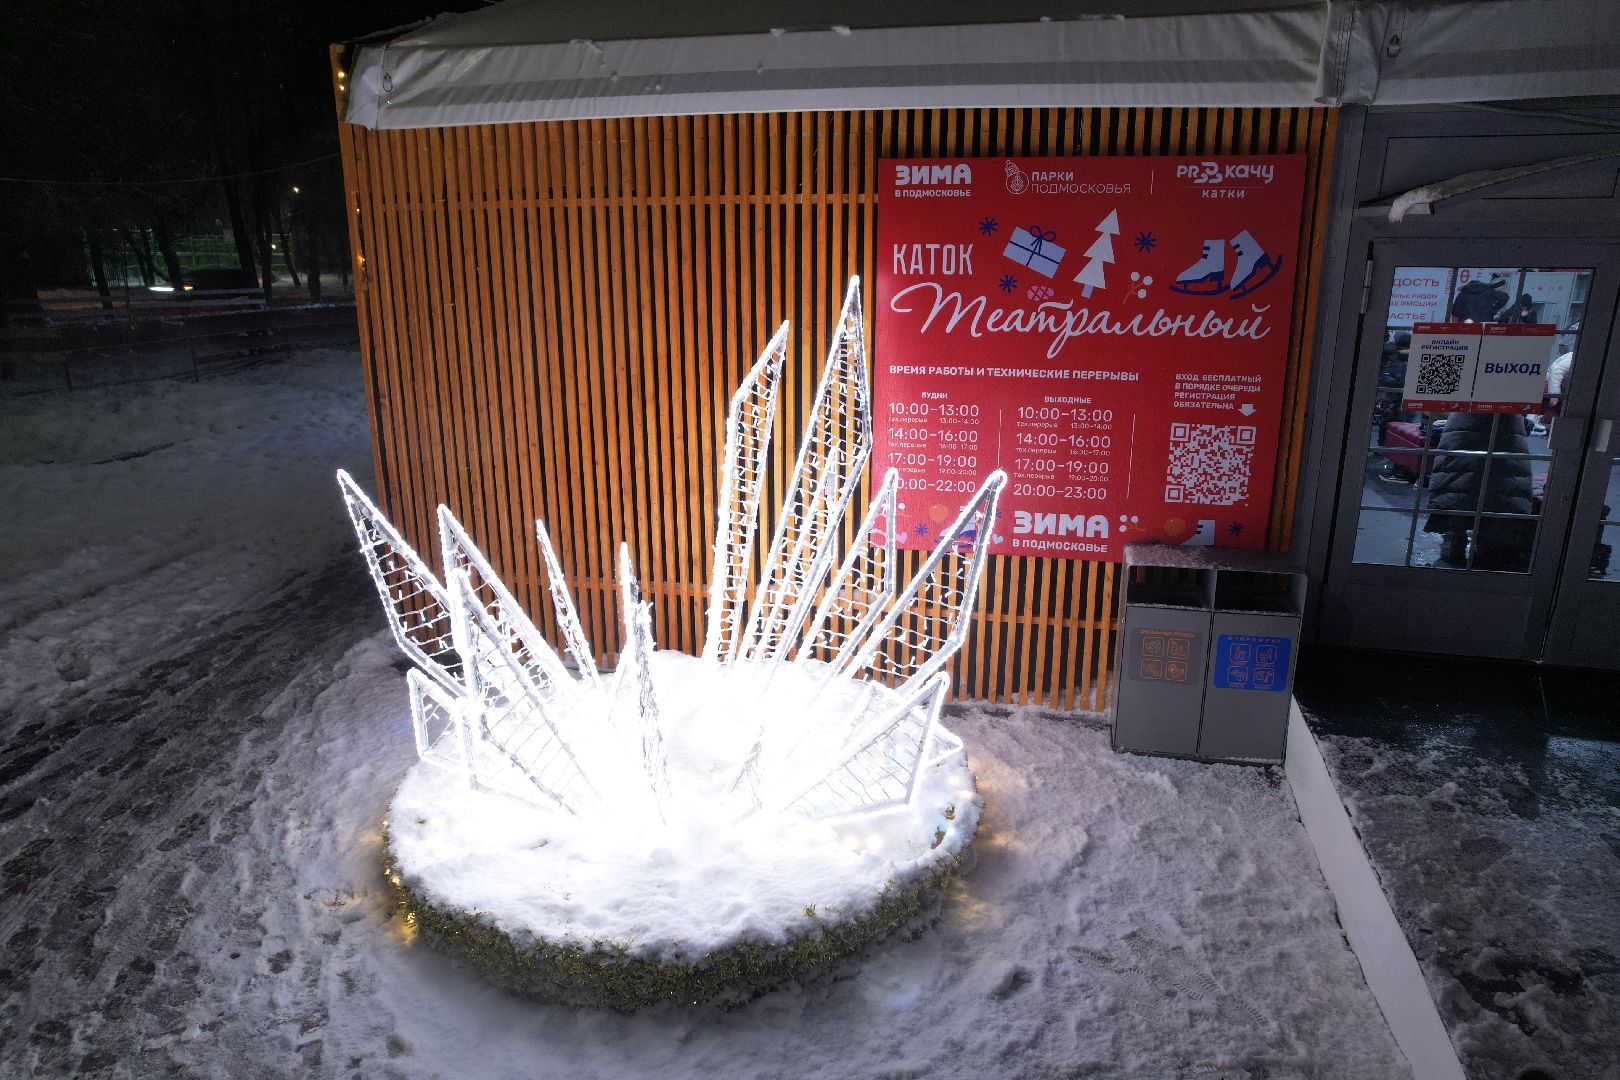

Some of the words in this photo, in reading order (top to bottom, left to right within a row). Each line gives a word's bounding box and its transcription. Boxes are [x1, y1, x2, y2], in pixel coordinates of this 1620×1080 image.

[895, 164, 972, 186] ЗИМА
[1031, 171, 1074, 182] ПАРКИ
[895, 189, 901, 198] В
[903, 189, 971, 199] ПОДМОСКОВЬЕ
[1031, 183, 1131, 195] ПОДМОСКОВЬЯ
[893, 243, 974, 275] КАТОК
[890, 282, 1271, 359] Театральный
[889, 365, 926, 375] ВРЕМЯ
[928, 366, 974, 376] РАБОТЫ
[976, 367, 985, 376] И
[987, 367, 1070, 379] ТЕХНИЧЕСКИЕ
[1072, 370, 1139, 381] ПЕРЕРЫВЫ
[1485, 362, 1541, 375] ВЫХОД
[1175, 373, 1199, 382] ВХОД
[1202, 374, 1262, 383] БЕСПЛАТНЫЙ
[1174, 382, 1181, 390] В
[1182, 383, 1221, 392] ПОРЯДКЕ
[1222, 384, 1261, 393] ОЧЕРЕДИ
[921, 391, 948, 399] БУДНИ
[1044, 395, 1092, 404] ВЫХОДНЫЕ
[1174, 391, 1236, 401] РЕГИСТРАЦИЯ
[1173, 400, 1235, 410] ОБЯЗАТЕЛЬНА
[897, 477, 976, 493] 0:00-22:00
[1013, 510, 1109, 538] ЗИМА
[1013, 539, 1020, 547] В
[1022, 540, 1108, 553] ПОДМОСКОВЬЕ
